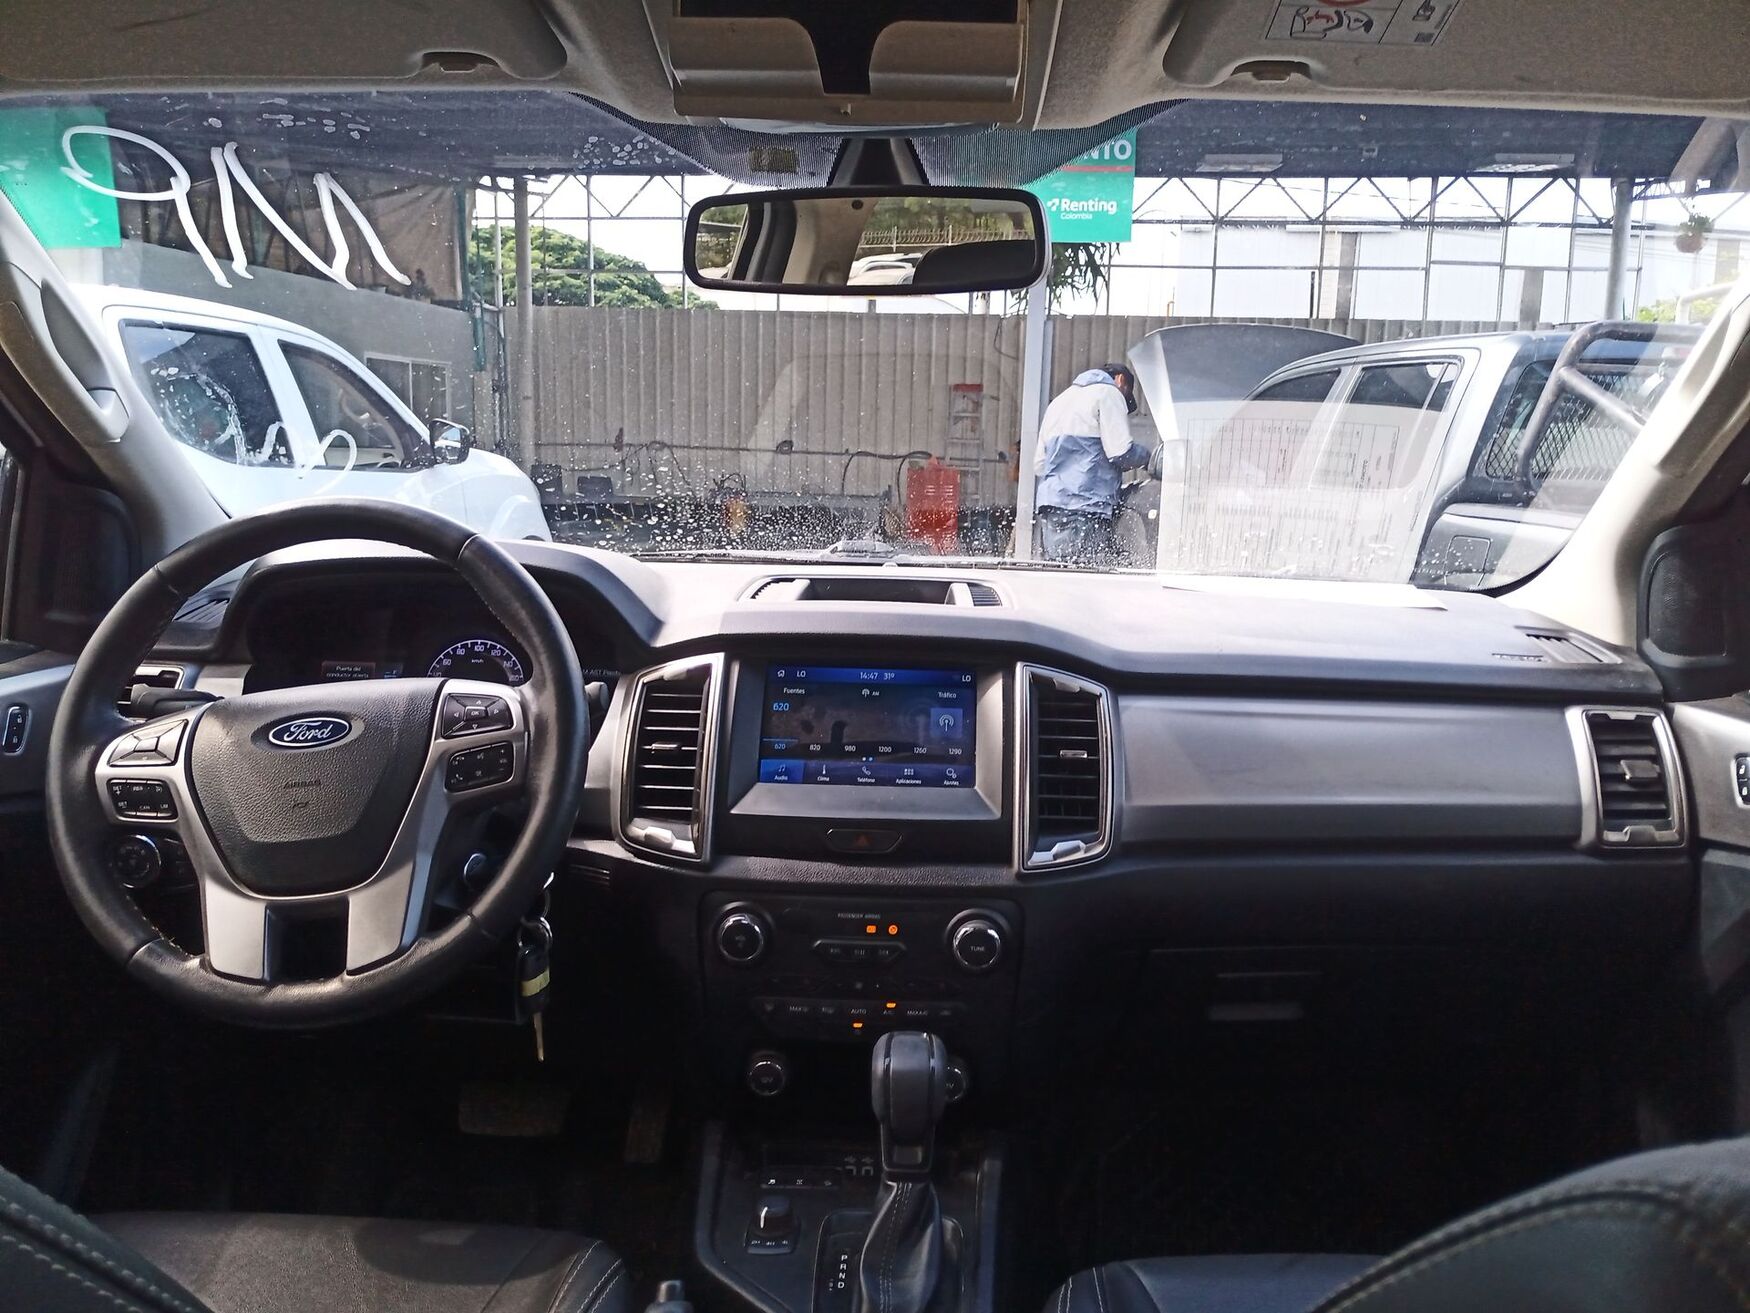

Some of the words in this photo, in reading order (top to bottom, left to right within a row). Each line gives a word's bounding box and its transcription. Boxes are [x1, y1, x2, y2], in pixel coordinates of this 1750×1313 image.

[1061, 198, 1118, 215] Renting
[1060, 212, 1093, 220] Colombia
[490, 649, 501, 657] 120
[796, 670, 806, 678] LO
[860, 672, 878, 680] 14:47
[962, 674, 972, 682] LO
[783, 687, 805, 695] Fuentes
[938, 691, 957, 699] Tráfico
[773, 702, 790, 711] 620
[283, 721, 334, 742] Ford
